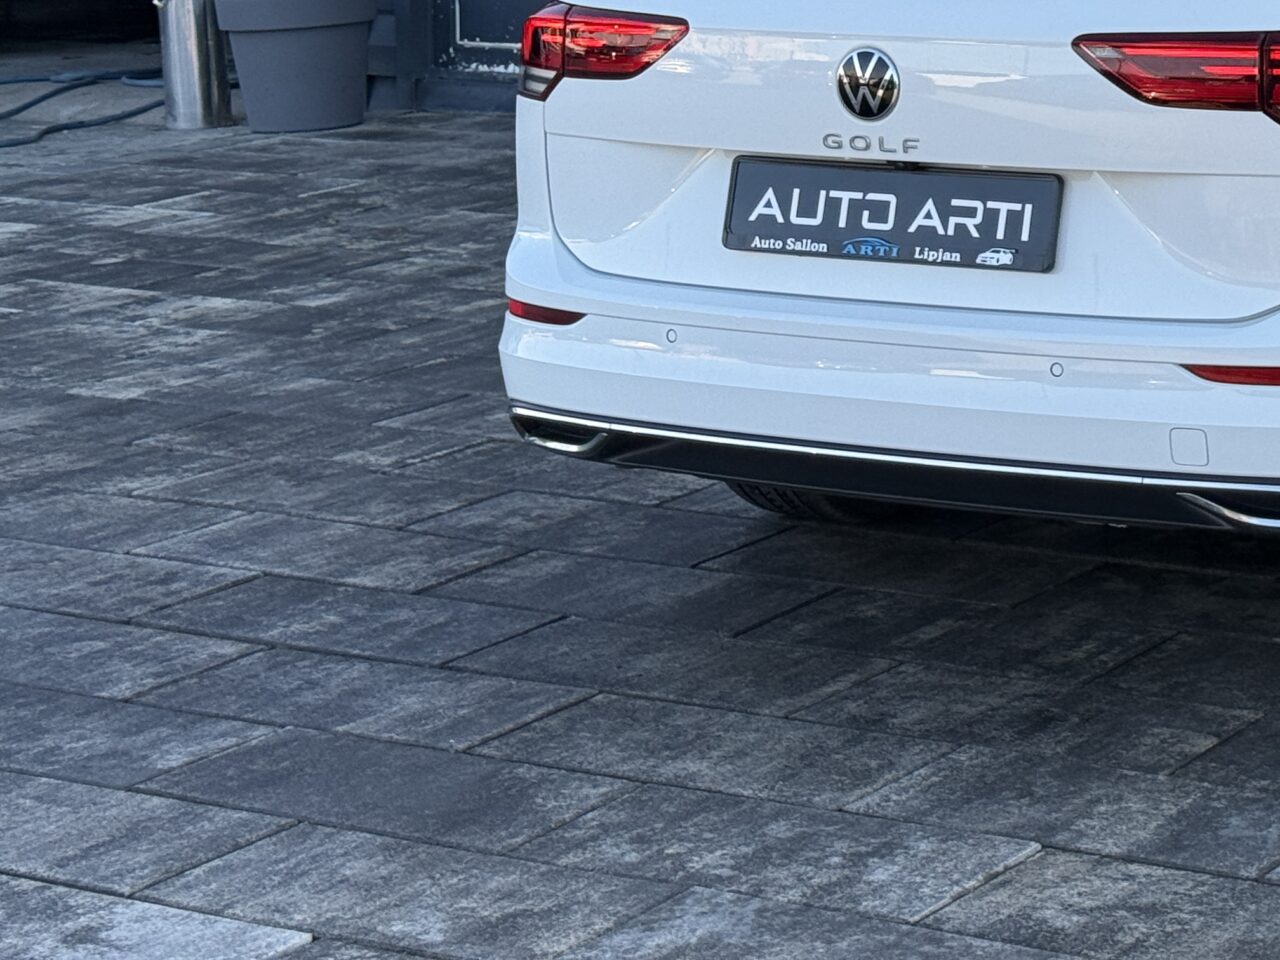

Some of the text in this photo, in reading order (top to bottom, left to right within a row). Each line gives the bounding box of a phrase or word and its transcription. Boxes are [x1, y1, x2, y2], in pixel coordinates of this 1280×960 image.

[822, 133, 920, 154] GOLF
[748, 186, 1033, 242] AUTO ARTI
[750, 235, 961, 263] Auto Sallon ARTI Lipjan
